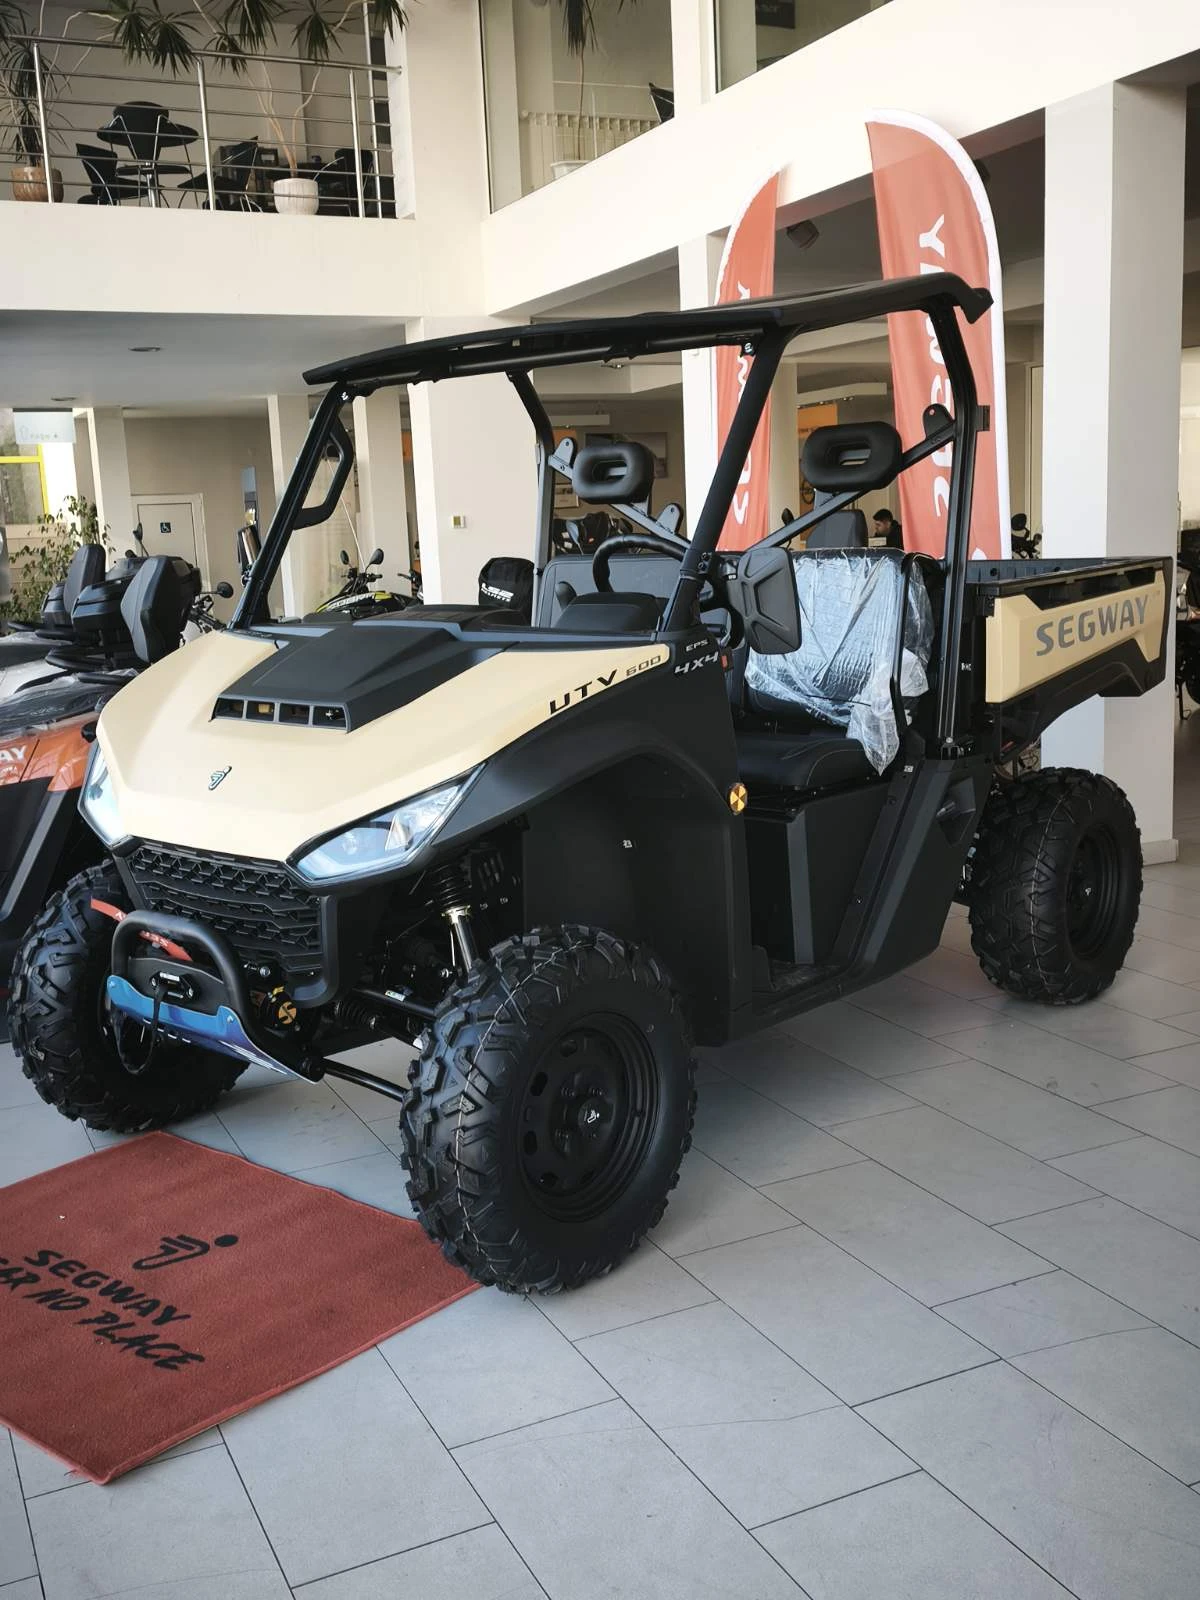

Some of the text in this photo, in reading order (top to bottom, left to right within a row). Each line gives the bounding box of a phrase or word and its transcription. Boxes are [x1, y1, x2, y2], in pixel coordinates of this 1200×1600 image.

[686, 639, 709, 652] EPS
[1036, 595, 1148, 657] SEGWAY
[549, 655, 662, 715] UTV 600
[23, 1249, 192, 1326] SEGWAY
[22, 1288, 91, 1311] NO
[74, 1310, 206, 1371] PLACE
